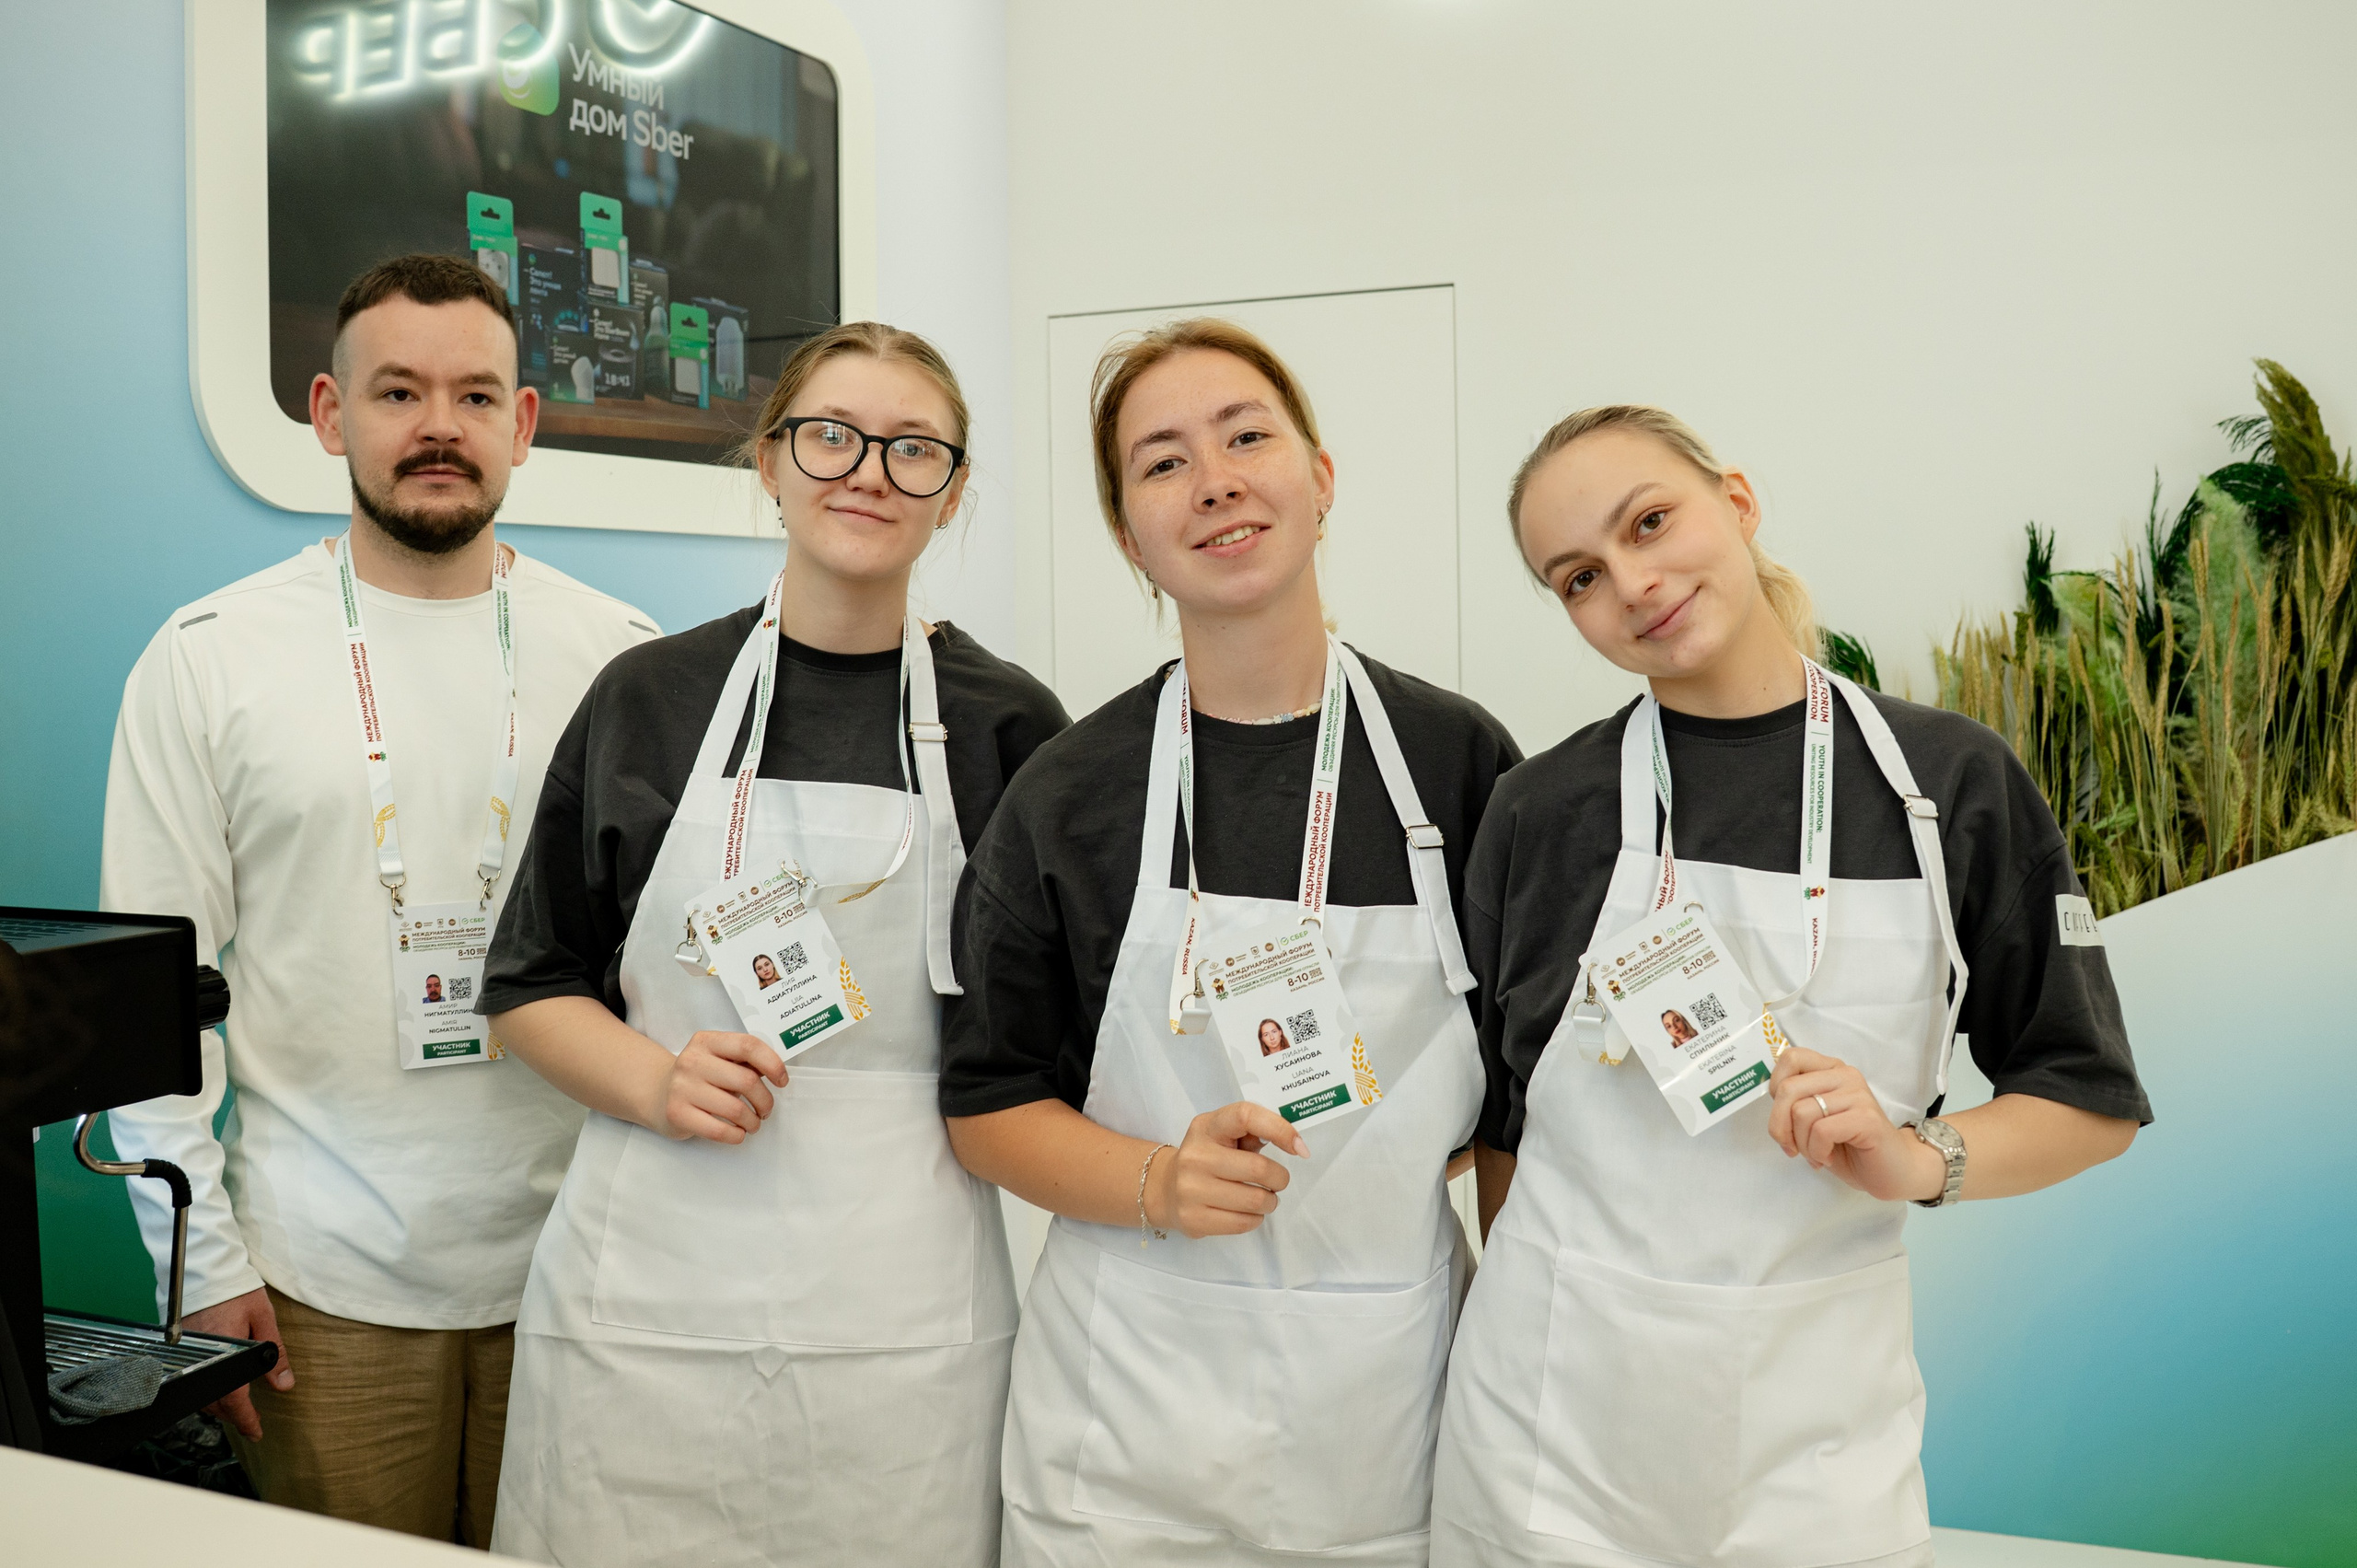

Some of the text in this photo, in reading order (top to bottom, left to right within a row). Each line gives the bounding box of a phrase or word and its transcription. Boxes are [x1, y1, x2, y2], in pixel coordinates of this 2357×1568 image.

[568, 41, 665, 110] Умный
[569, 98, 694, 160] дом Sber
[343, 598, 353, 627] МОЛОДЕЖЬ
[351, 644, 374, 742] МЕЖДУНАРОДНЫЙ ФОРУМ
[359, 642, 381, 741] ПОТРЕБИТЕЛЬСКОЙ КООПЕРАЦИИ
[1820, 687, 1829, 722] FORUM
[1321, 733, 1331, 771] МОЛОДЕЖЬ
[1818, 771, 1824, 779] IN
[740, 768, 754, 815] КООПЕРАЦИИ
[1313, 791, 1323, 824] ФОРУМ
[1816, 781, 1824, 832] COOPERATION:
[724, 769, 748, 881] ЕЖДУНАРОДНЫЙ ФОРУМ
[1314, 793, 1332, 912] ПОТРЕБИТЕЛЬСКОЙ КООПЕРАЦИИ
[772, 872, 787, 883] СБЕ
[718, 881, 793, 923] МЕЖДУНАРОДНЫЙ ФОРУМ
[721, 887, 795, 929] ПОТРЕБИТЕЛЬСКОЙ КООПЕРАЦИИ
[774, 910, 793, 923] 8-10
[1675, 917, 1694, 931] СБЕР
[1290, 931, 1308, 941] СБЕР
[458, 948, 476, 957] 8-10
[1182, 947, 1190, 975] RUSSIA
[1225, 943, 1312, 978] МЕЖДУНАРОДНЫЙ ФОРУМ
[1228, 949, 1315, 983] ПОТРЕБИТЕЛЬСКОЙ КООПЕРАЦИИ
[1618, 928, 1700, 979] МЕЖДУНАРОДНЫЙ ФОРУМ
[1622, 934, 1703, 983] ПОТРЕБИТЕЛЬСКОЙ КООПЕРАЦИИ
[1682, 958, 1703, 974] 8-10
[767, 974, 818, 1005] АДИАТУЛЛИНА
[782, 976, 796, 988] ЛИЯ
[1231, 980, 1259, 992] МОЛОДЕЖЬ
[1287, 973, 1308, 986] 8-10
[424, 1008, 474, 1018] НИГМАТУЛЛИН
[780, 993, 822, 1020] ADIATULLINA
[429, 1025, 470, 1034] NIGMATULLIN
[790, 1007, 830, 1037] УЧАСТНИК
[798, 1021, 829, 1040] PARTICIPANT
[433, 1041, 470, 1051] УЧАСТНИК
[1684, 1025, 1726, 1052] ЕКАТЕРИНА
[1689, 1032, 1731, 1059] СПИЛЬНИК
[1274, 1050, 1322, 1072] ХУСАИНОВА
[1282, 1046, 1309, 1060] ЛИАНА
[1698, 1044, 1736, 1071] EKATERINA
[1707, 1055, 1736, 1074] SPILNIK
[1281, 1070, 1330, 1092] KHUSAINOVA
[1292, 1067, 1314, 1079] LIANA
[1712, 1070, 1757, 1098] УЧАСТНИК
[1291, 1091, 1337, 1112] УЧАСТНИК
[1722, 1080, 1756, 1102] PARTICIPANT
[1299, 1100, 1334, 1117] PARTICIPANT
